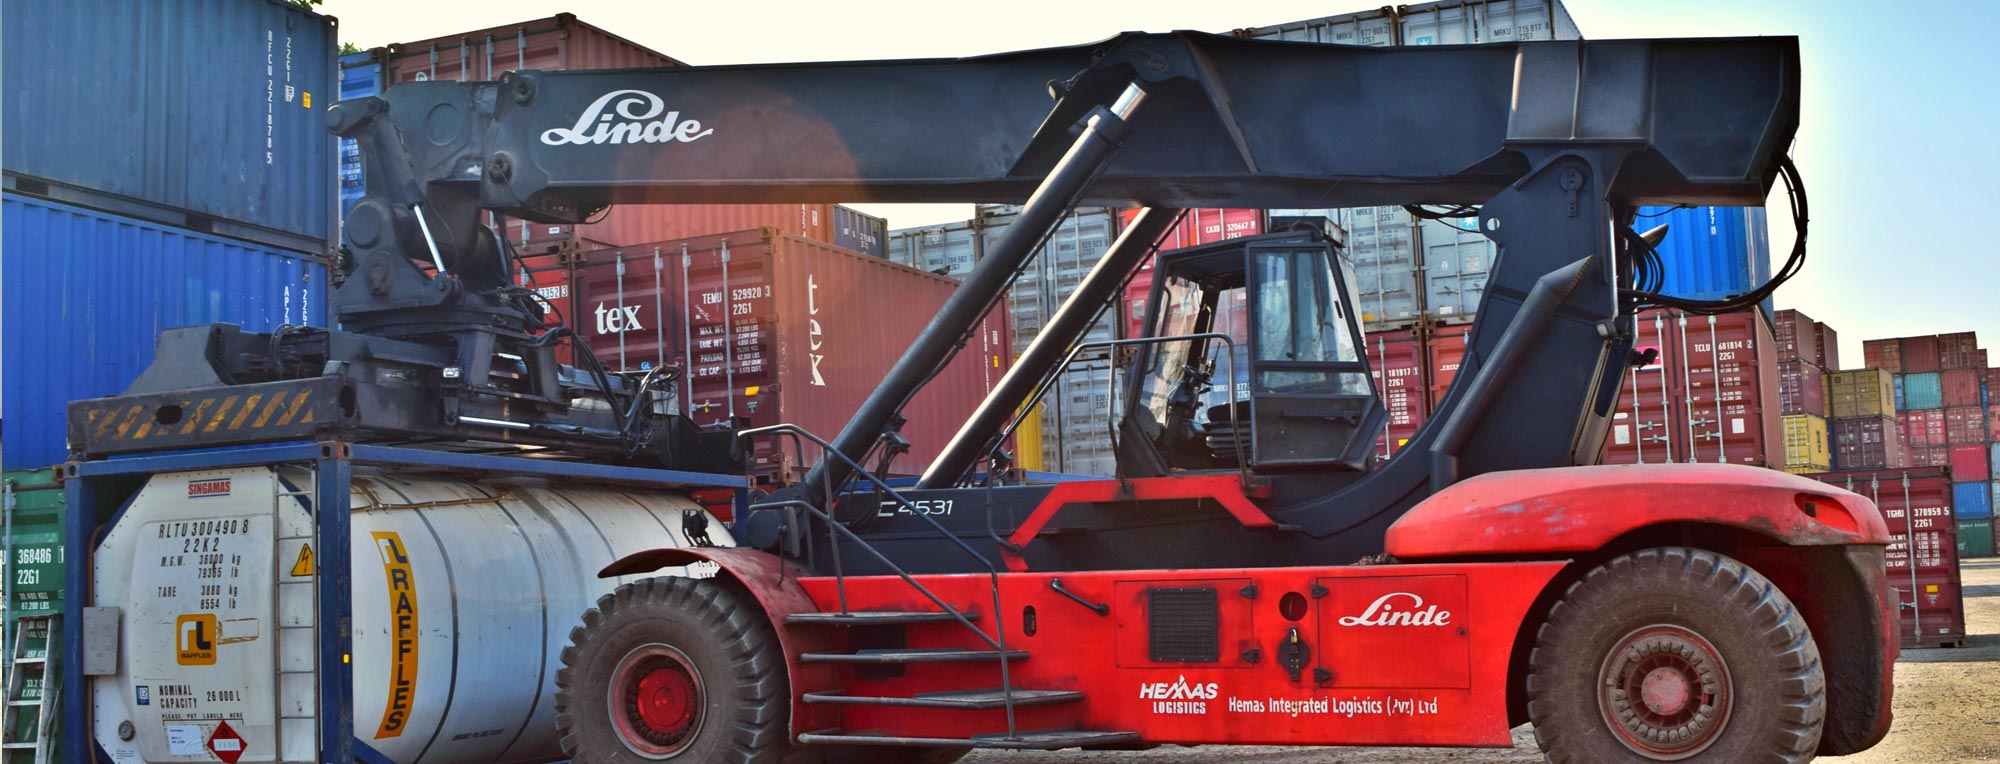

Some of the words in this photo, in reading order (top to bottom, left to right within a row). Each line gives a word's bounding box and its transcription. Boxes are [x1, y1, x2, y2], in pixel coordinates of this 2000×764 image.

[1494, 28, 1511, 36] MRKU
[1518, 24, 1530, 33] 715
[1519, 32, 1533, 40] 22G1
[540, 89, 714, 146] Linde
[266, 151, 272, 164] 5
[1356, 208, 1373, 216] MRKU
[1380, 213, 1394, 222] 22G1
[562, 285, 568, 298] 3
[702, 291, 722, 305] TEMU
[732, 286, 762, 301] 529920
[764, 285, 771, 298] 3
[733, 302, 752, 316] 22G1
[594, 301, 643, 335] tex
[808, 273, 826, 386] tex
[699, 339, 712, 348] TARE
[1694, 343, 1711, 353] TCLU
[1718, 341, 1743, 351] 681814
[1747, 340, 1753, 349] 2
[700, 354, 724, 364] PAYLOAD
[1719, 351, 1735, 360] 22G1
[1388, 368, 1411, 378] 181917
[1388, 378, 1404, 387] 22G1
[188, 481, 231, 495] SINGAMAS
[1886, 509, 1905, 519] TGHU
[1914, 507, 1941, 516] 370959
[1944, 506, 1950, 516] 5
[159, 523, 188, 539] RLTU
[191, 520, 237, 537] 300490
[242, 519, 249, 534] 8
[1914, 518, 1933, 528] 22G1
[183, 537, 220, 553] 22K2
[18, 549, 52, 564] 368486
[161, 555, 186, 567] M.G.W.
[199, 554, 224, 565] 36000
[232, 553, 241, 566] kg
[17, 569, 39, 584] 22G1
[198, 567, 222, 579] 79365
[231, 567, 239, 578] lb
[158, 586, 177, 598] TARE
[228, 584, 238, 597] kg
[40, 601, 50, 609] LBS
[200, 599, 220, 610] 8554
[229, 598, 237, 609] lb
[1338, 592, 1451, 627] Linde
[384, 568, 413, 732] RAFFLES
[159, 685, 192, 696] NOMINAL
[1139, 676, 1218, 699] HEMAS
[206, 691, 217, 702] 26
[219, 691, 234, 702] 000
[236, 690, 241, 702] L
[160, 698, 198, 709] CAPACITY
[1153, 701, 1206, 714] LOGISTICS
[1229, 697, 1265, 713] Hemas
[1269, 696, 1329, 717] Integrated
[1333, 696, 1382, 717] Logistics
[1418, 697, 1437, 714] Ltd
